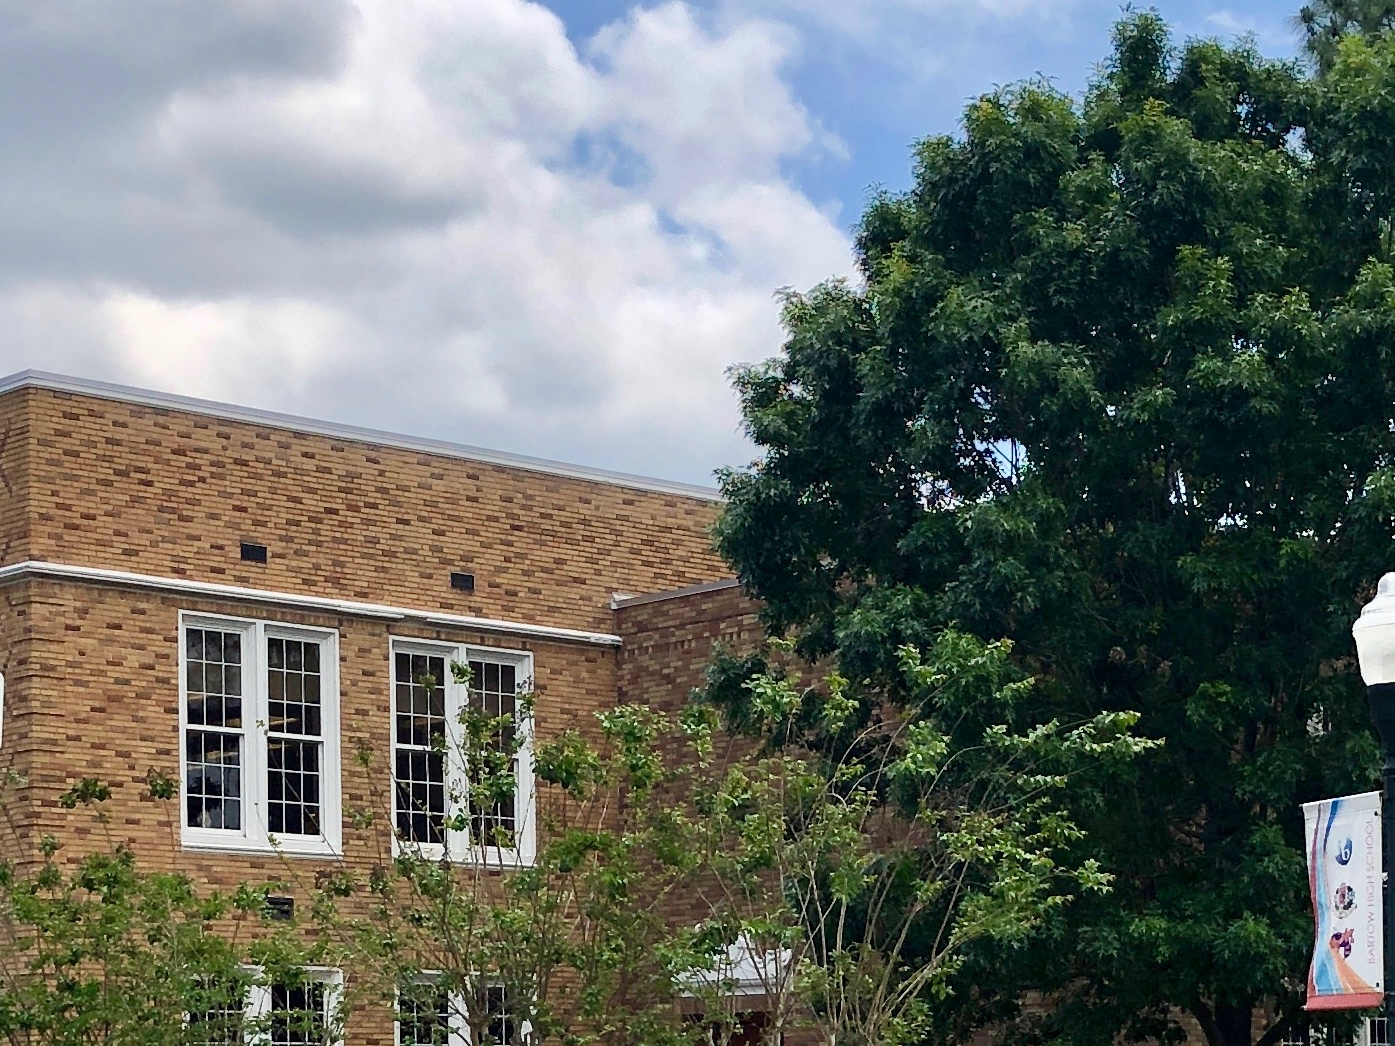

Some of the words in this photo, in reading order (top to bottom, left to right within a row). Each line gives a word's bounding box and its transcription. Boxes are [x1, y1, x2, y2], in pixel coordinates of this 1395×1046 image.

[1365, 818, 1376, 872] SCHOOL
[1366, 873, 1376, 908] HIGH
[1367, 910, 1376, 965] BARTOW
